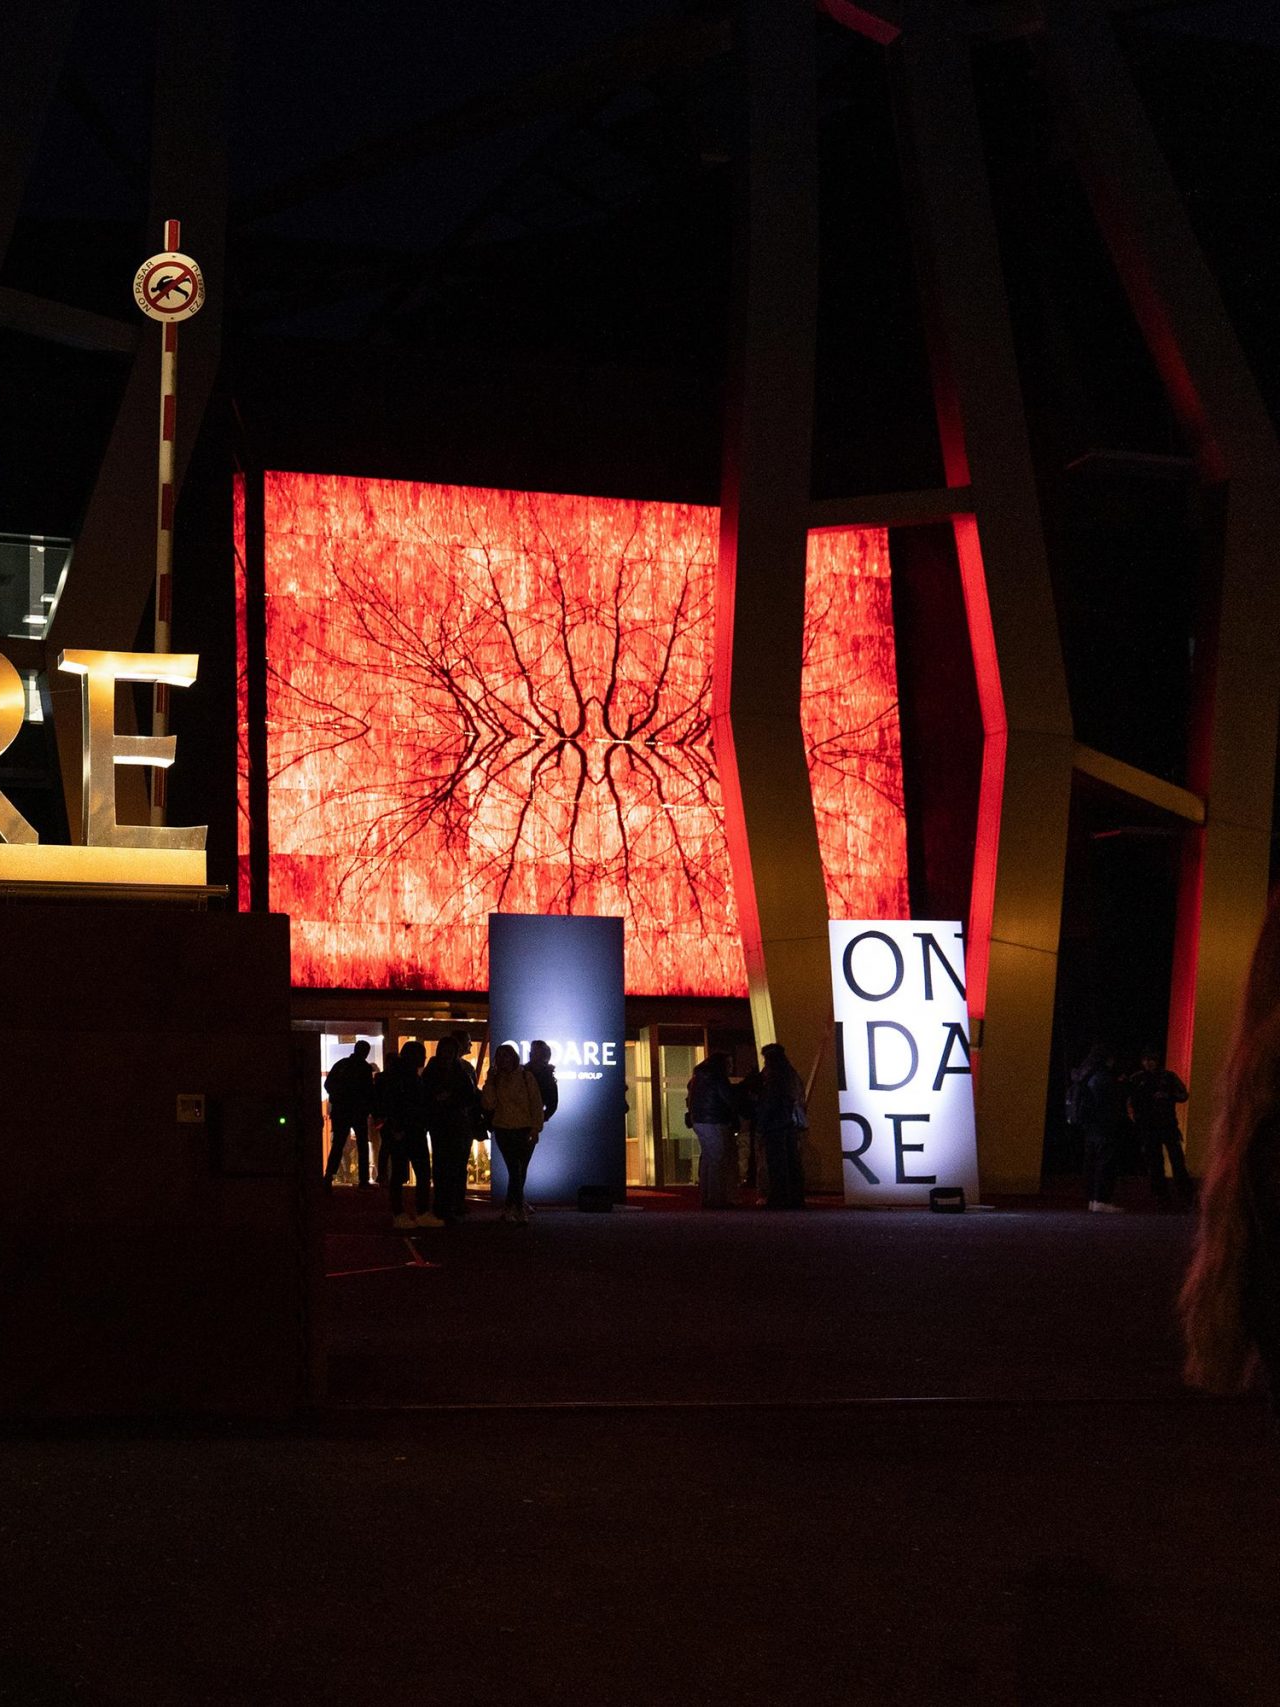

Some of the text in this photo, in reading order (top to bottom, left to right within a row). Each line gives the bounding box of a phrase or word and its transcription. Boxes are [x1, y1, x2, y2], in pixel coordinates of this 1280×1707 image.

[135, 261, 154, 312] NO PASAR
[188, 300, 202, 314] EZ
[839, 1112, 936, 1185] RE
